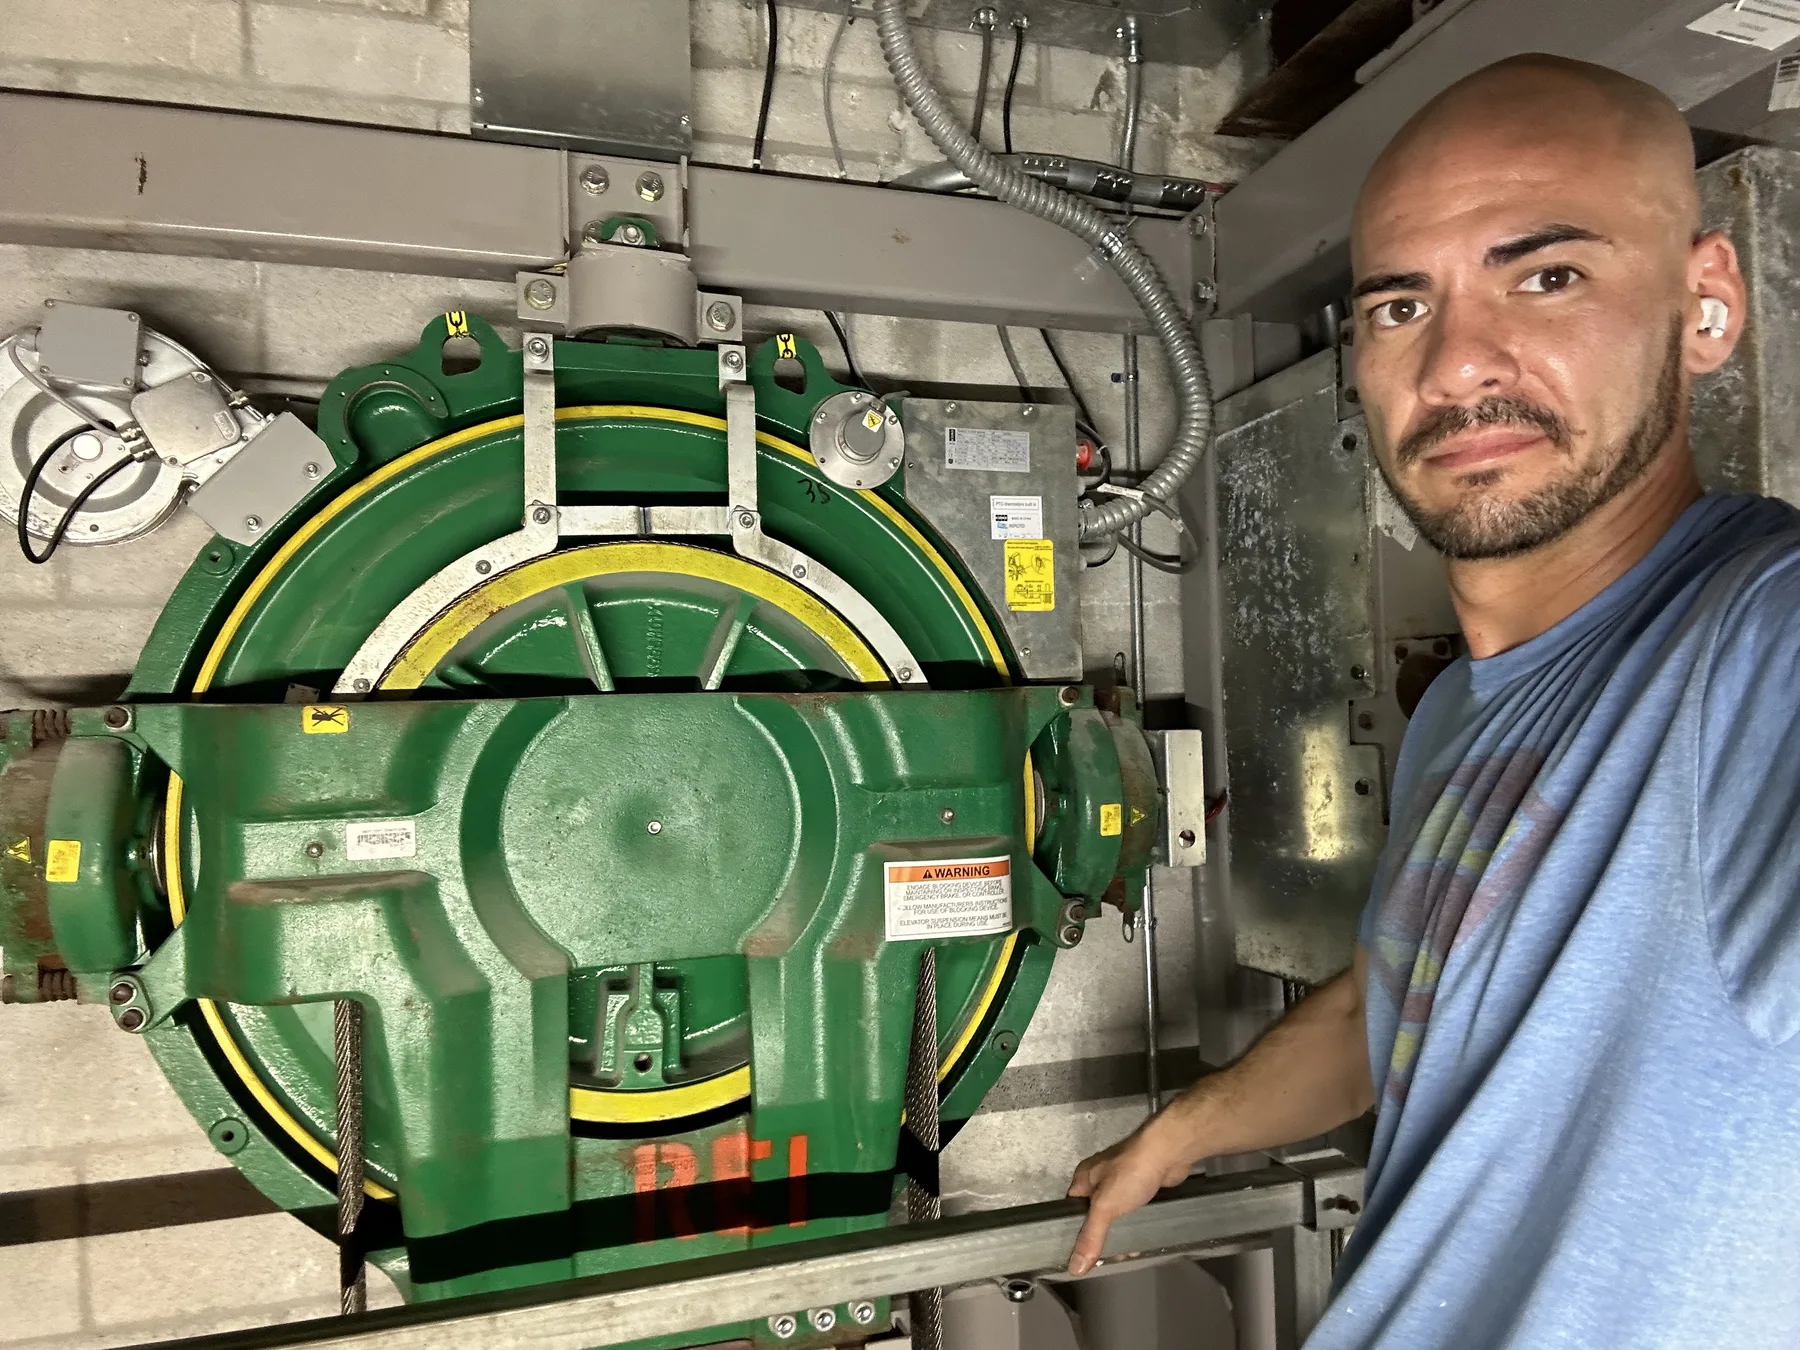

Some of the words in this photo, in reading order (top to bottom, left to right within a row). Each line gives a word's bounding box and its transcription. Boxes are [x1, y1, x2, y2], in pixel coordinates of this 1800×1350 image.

[935, 866, 990, 878] WARNING
[932, 882, 962, 890] BLOCKING
[903, 894, 939, 902] EMERGENCY
[949, 905, 978, 913] BLOCKING
[900, 918, 930, 926] ELEVATOR
[931, 916, 968, 924] SUSPENSION
